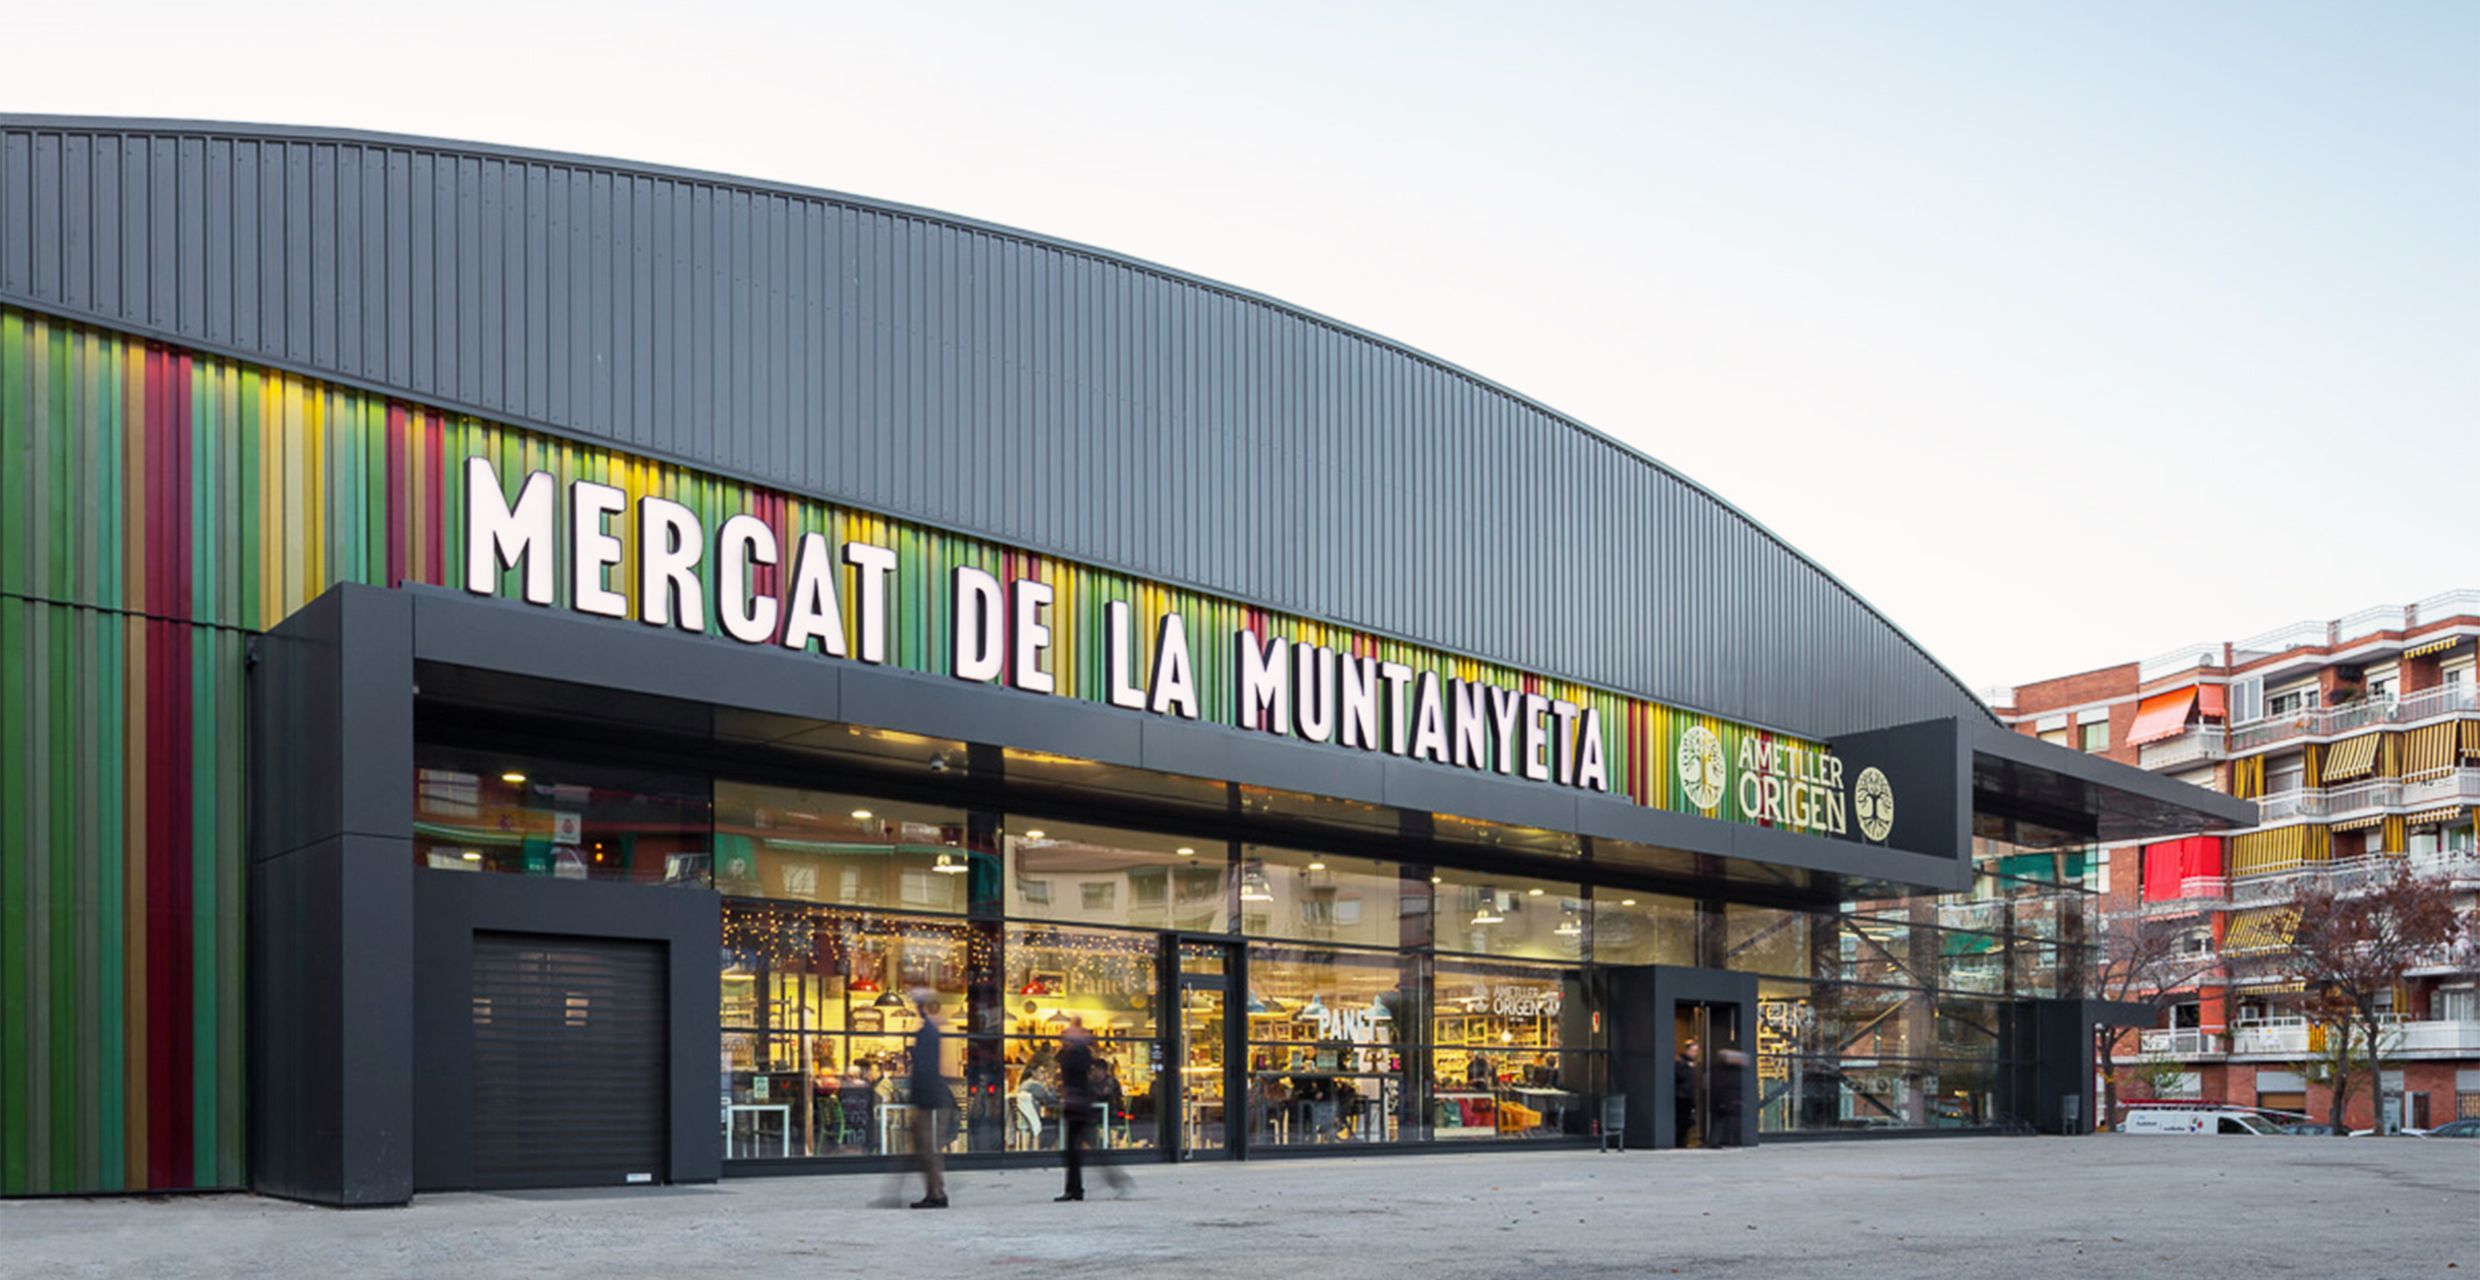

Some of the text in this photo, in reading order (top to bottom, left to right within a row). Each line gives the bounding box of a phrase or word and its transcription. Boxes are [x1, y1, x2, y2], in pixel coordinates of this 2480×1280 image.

[464, 456, 1609, 792] MERCAT DE LA MUNTANYETA
[1738, 735, 1845, 790] AMETLLER
[1738, 770, 1847, 835] ORIGEN
[1493, 998, 1541, 1016] ORIGEN
